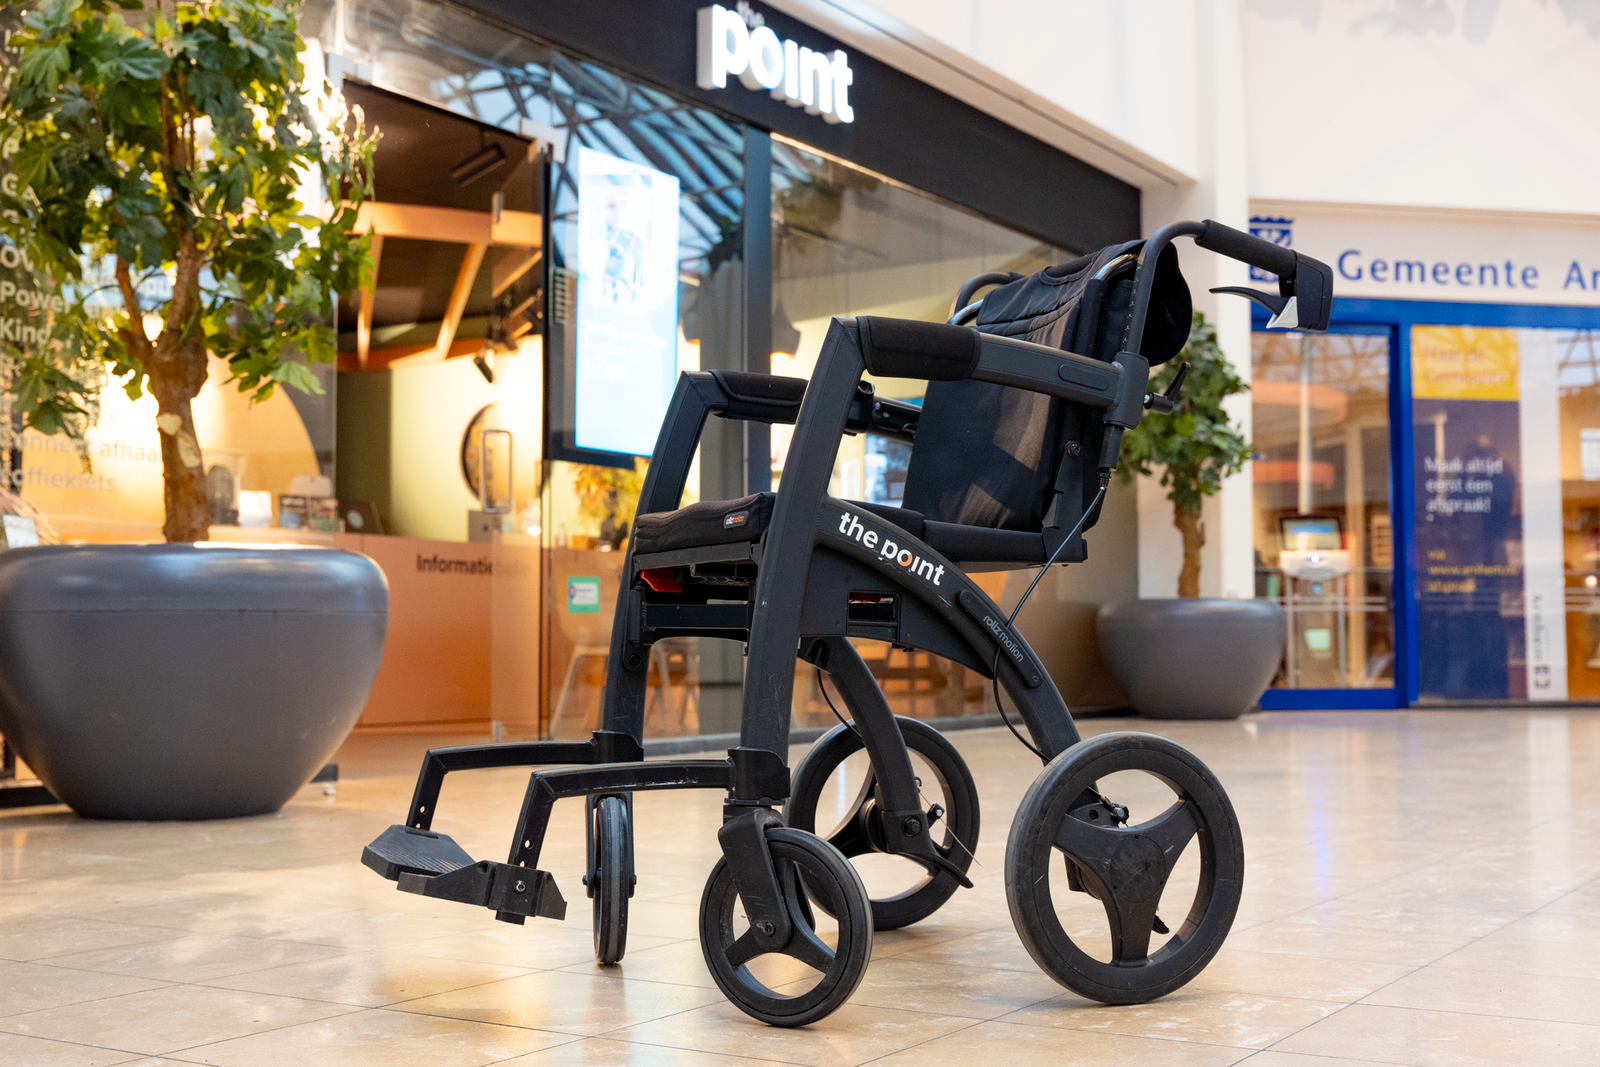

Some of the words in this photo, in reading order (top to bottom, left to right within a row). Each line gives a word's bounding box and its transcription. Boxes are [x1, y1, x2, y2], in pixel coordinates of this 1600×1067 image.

[698, 4, 854, 123] point
[1338, 249, 1540, 290] Gemeente
[1465, 479, 1493, 493] een
[838, 511, 878, 549] the
[878, 538, 945, 586] point
[983, 615, 1003, 635] rollz
[999, 632, 1024, 662] motion
